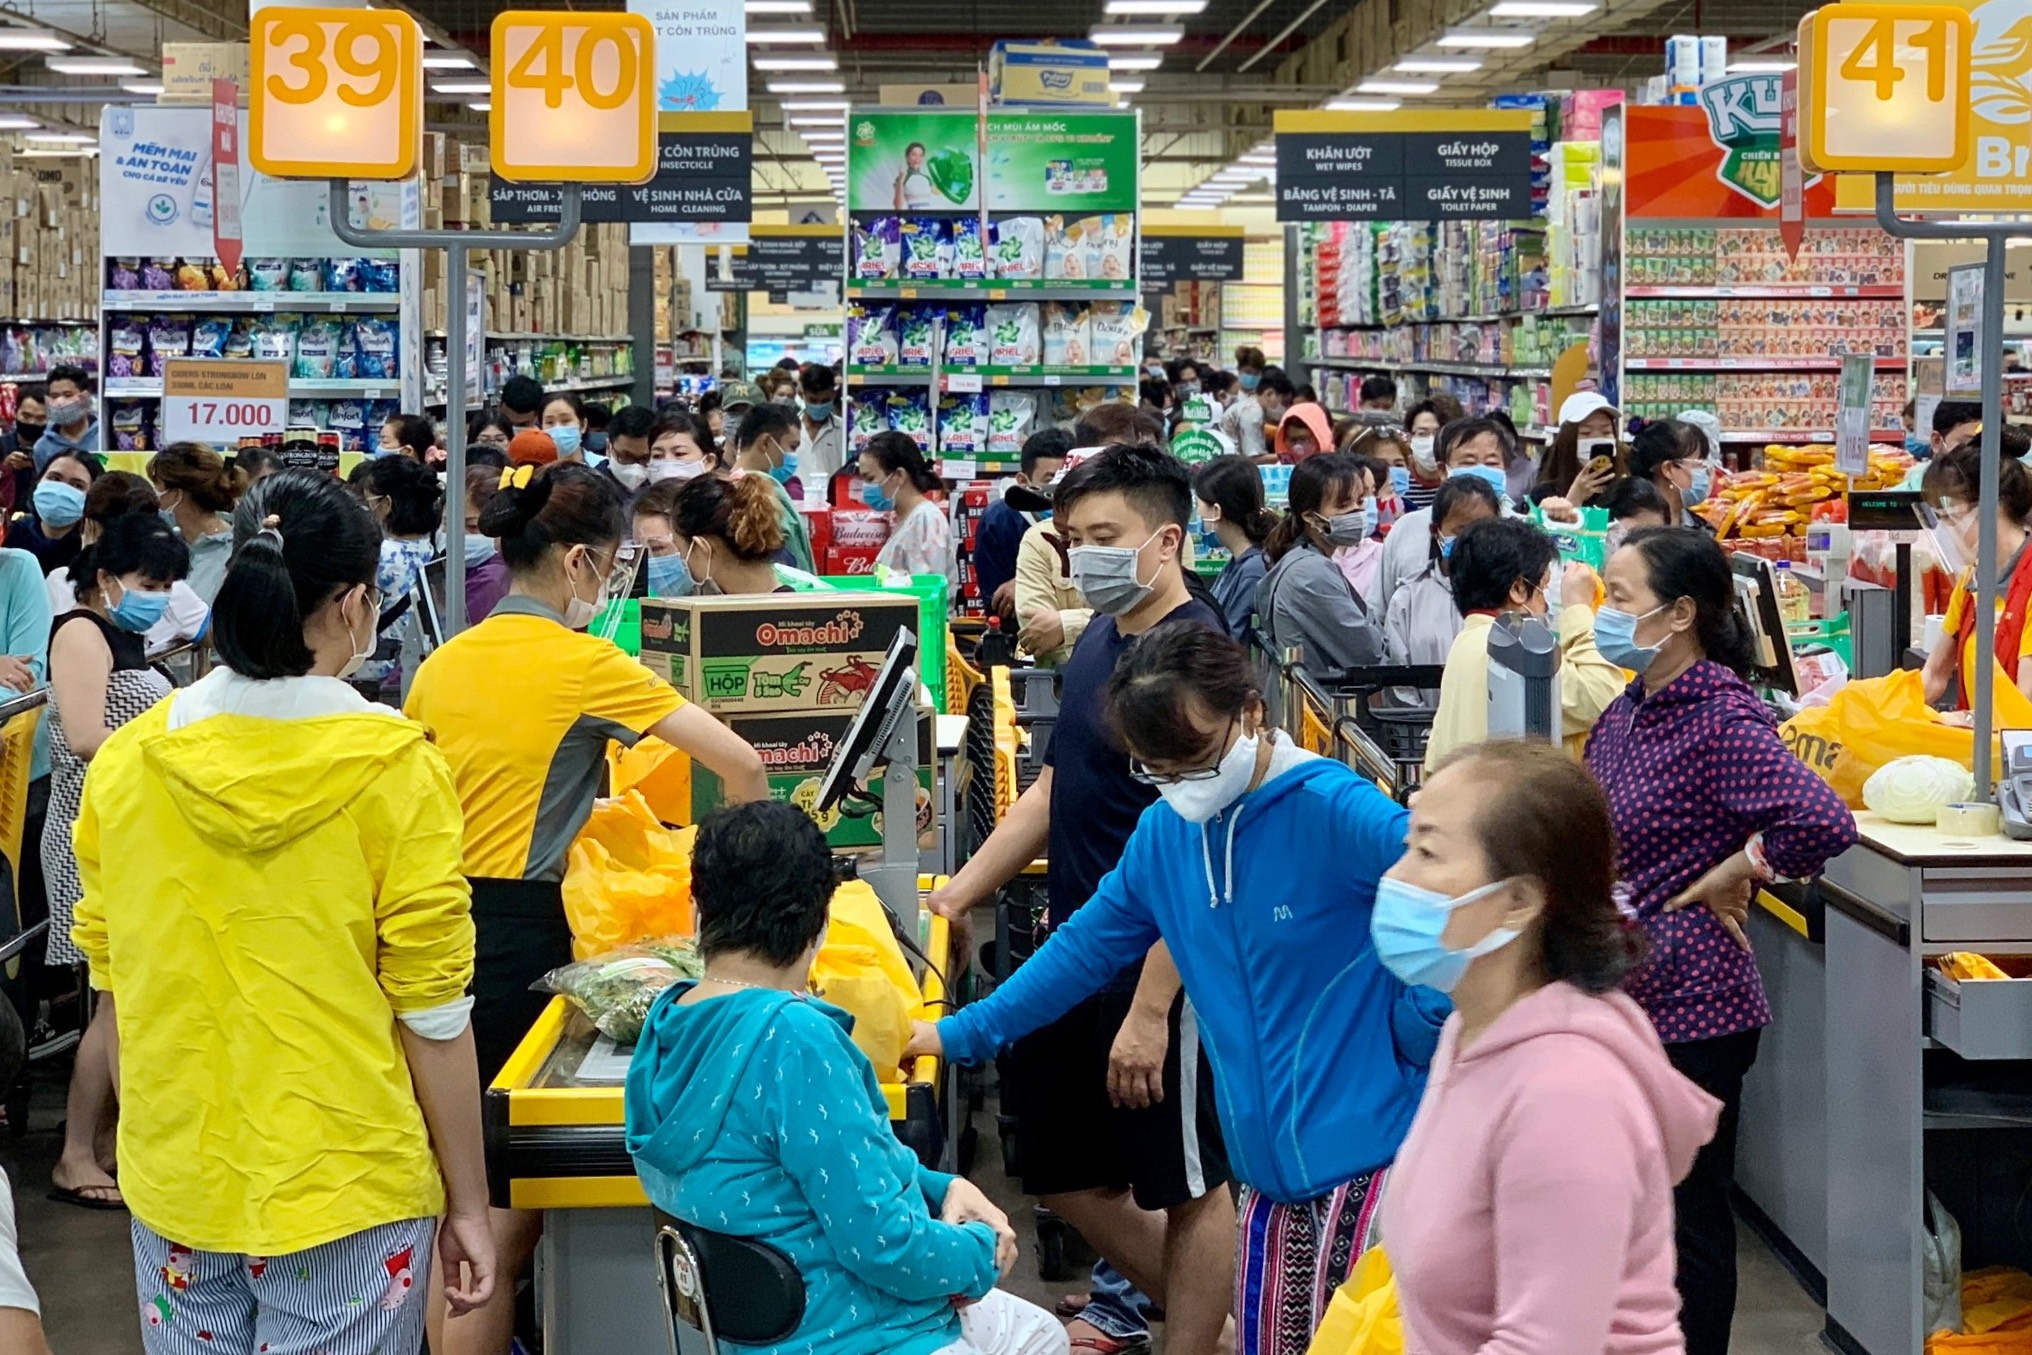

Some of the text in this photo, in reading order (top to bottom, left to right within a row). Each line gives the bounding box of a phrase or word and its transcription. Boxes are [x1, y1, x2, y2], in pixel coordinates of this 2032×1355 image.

[667, 24, 692, 36] CÔN
[267, 20, 398, 107] 39
[508, 25, 637, 109] 40
[1840, 19, 1946, 103] 41
[1708, 80, 1782, 136] KU
[665, 144, 740, 158] CÔN TRÙNG
[1306, 145, 1372, 160] KHĂN ƯỚT
[1437, 141, 1499, 158] GIẤY HỘP
[126, 157, 150, 169] AN
[1315, 162, 1363, 171] WET WIPES
[1445, 158, 1492, 167] TISSUE BOX
[38, 170, 62, 182] OMO
[493, 187, 514, 201] SÁP
[515, 188, 549, 201] THƠM
[580, 187, 617, 201] HÒNG
[632, 189, 649, 204] VỆ
[650, 190, 680, 201] SINH
[681, 187, 713, 201] NHÀ
[1283, 186, 1320, 200] BĂNG
[1322, 186, 1338, 202] VỆ
[1339, 189, 1370, 200] SINH
[1379, 186, 1396, 200] TÃ
[1427, 185, 1510, 202] GIẤY VỆ SINH
[2005, 184, 2032, 198] TRỌN
[527, 205, 542, 213] AIR
[650, 205, 726, 213] HOME CLEANING
[1303, 203, 1341, 212] TAMPON
[1346, 203, 1377, 212] DIAPER
[1440, 203, 1497, 212] TOILET PAPER
[187, 403, 271, 426] 17.000
[756, 620, 848, 646] Omachi
[710, 673, 745, 694] HỘP
